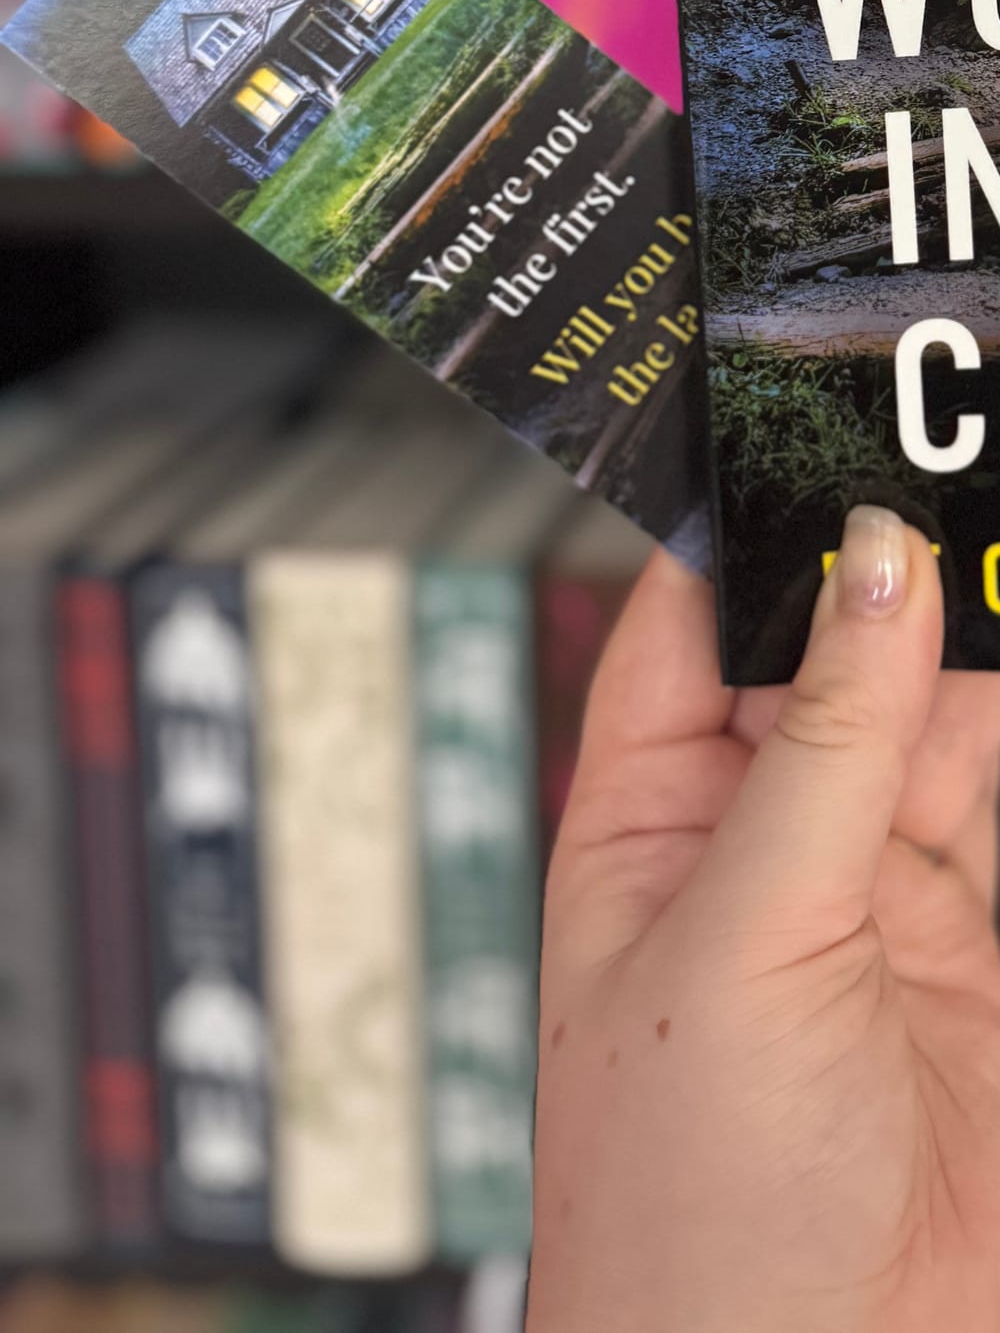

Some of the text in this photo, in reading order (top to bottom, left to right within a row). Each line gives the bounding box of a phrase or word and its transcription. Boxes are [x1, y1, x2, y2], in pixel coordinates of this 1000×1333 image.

[408, 107, 593, 293] You're not
[486, 170, 637, 318] the first.
[529, 305, 617, 386] Will
[604, 241, 677, 323] you
[606, 341, 676, 406] the
